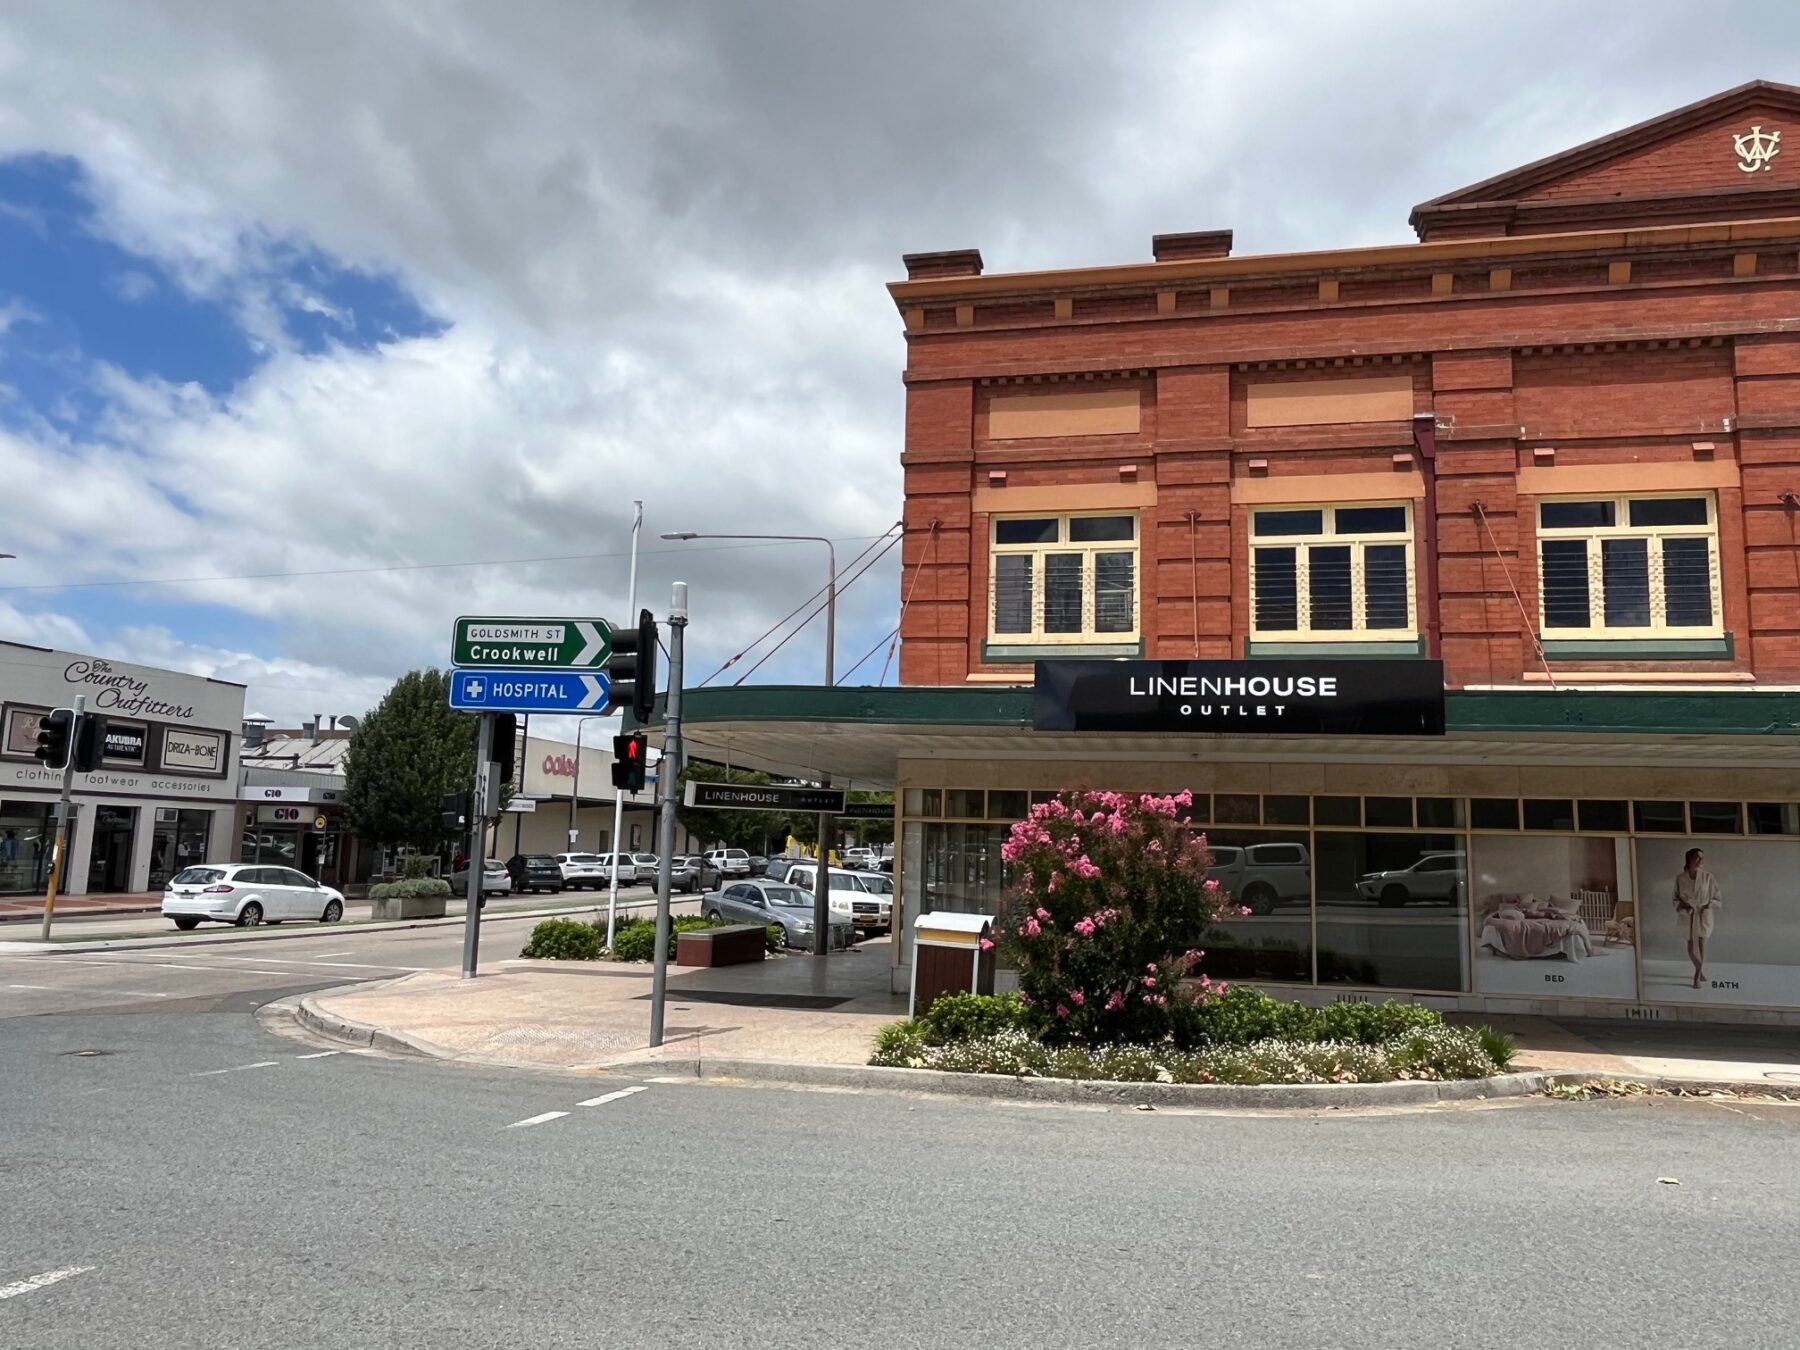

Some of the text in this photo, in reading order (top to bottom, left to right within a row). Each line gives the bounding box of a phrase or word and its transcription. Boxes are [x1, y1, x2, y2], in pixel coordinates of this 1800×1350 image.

[471, 628, 561, 639] GOLDSMITH ST
[470, 645, 558, 661] Crookwell
[92, 660, 112, 674] The
[64, 661, 148, 697] Country
[493, 683, 568, 699] HOSPITAL
[1130, 676, 1337, 697] LINENHOUSE
[96, 687, 194, 718] Outfitters
[1180, 704, 1286, 716] OUTLET
[105, 734, 142, 748] AKUBRA
[167, 742, 217, 758] DRIZA-BONE
[16, 769, 210, 792] clothin footwear accessories
[705, 791, 780, 803] LINENHOUSE
[274, 808, 299, 820] GIO
[1544, 974, 1565, 983] BED
[1711, 981, 1739, 989] BATH
